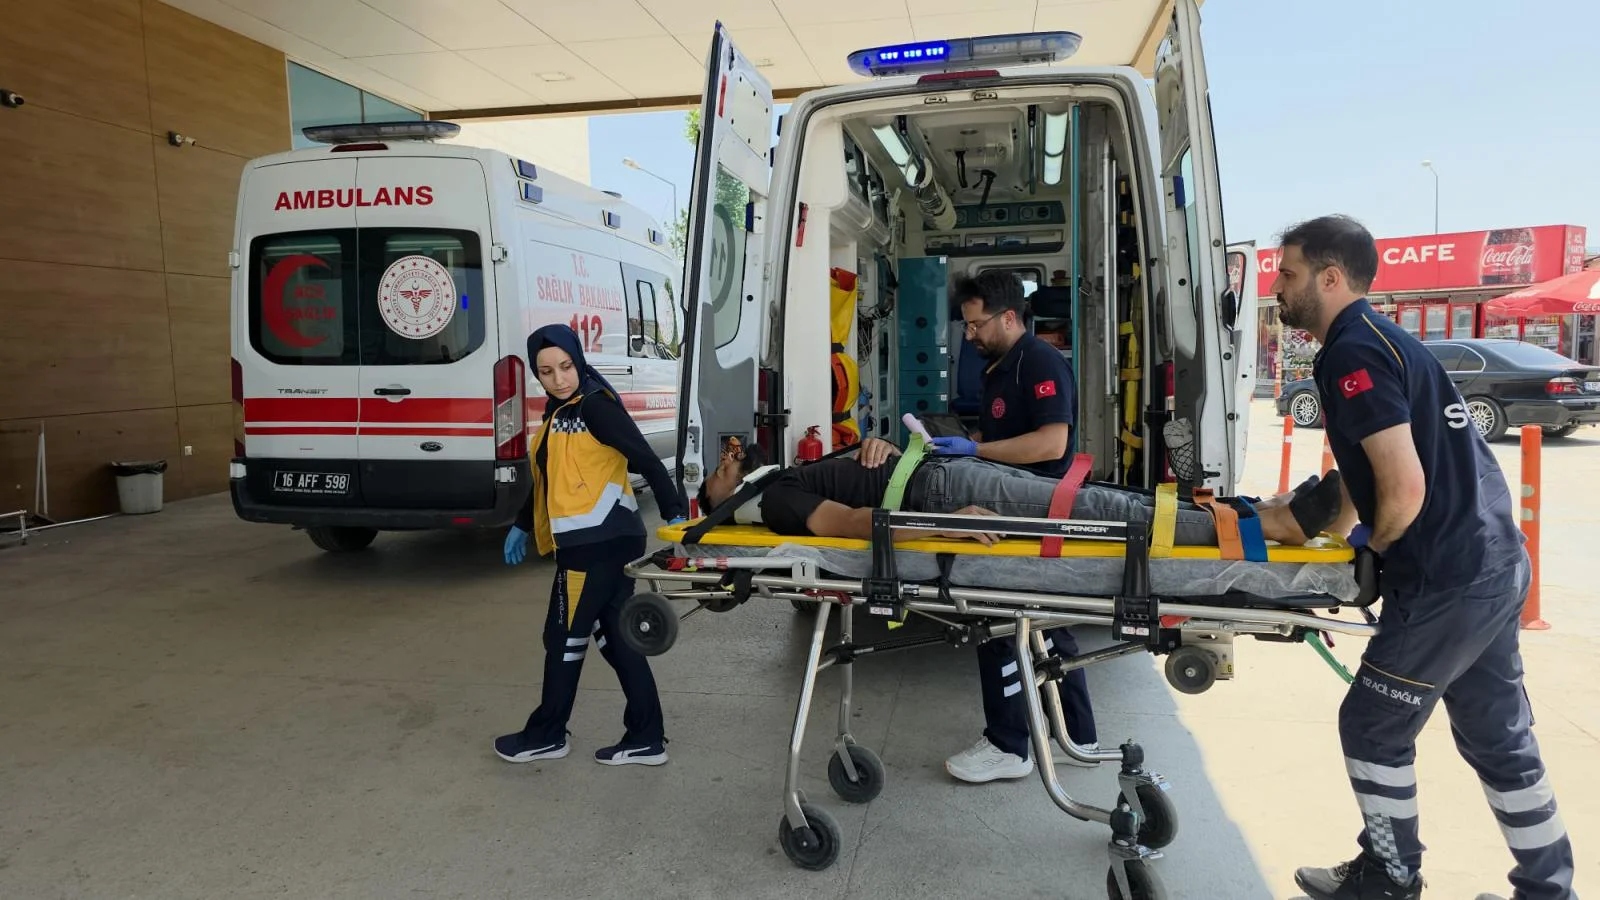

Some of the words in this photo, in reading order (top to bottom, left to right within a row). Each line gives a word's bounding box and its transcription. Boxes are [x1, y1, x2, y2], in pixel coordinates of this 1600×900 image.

[274, 186, 434, 210] AMBULANS
[571, 253, 590, 278] T.C.
[1383, 243, 1455, 265] CAFE
[536, 274, 575, 304] SAĞLIK
[579, 283, 623, 313] BAKANLIĞI
[570, 313, 603, 353] 112
[282, 473, 294, 487] 16
[298, 473, 319, 488] AFF
[325, 474, 347, 490] 598
[1061, 524, 1107, 534] SPENCER
[1372, 682, 1389, 696] ACİL
[1390, 689, 1422, 706] SAĞLIK
